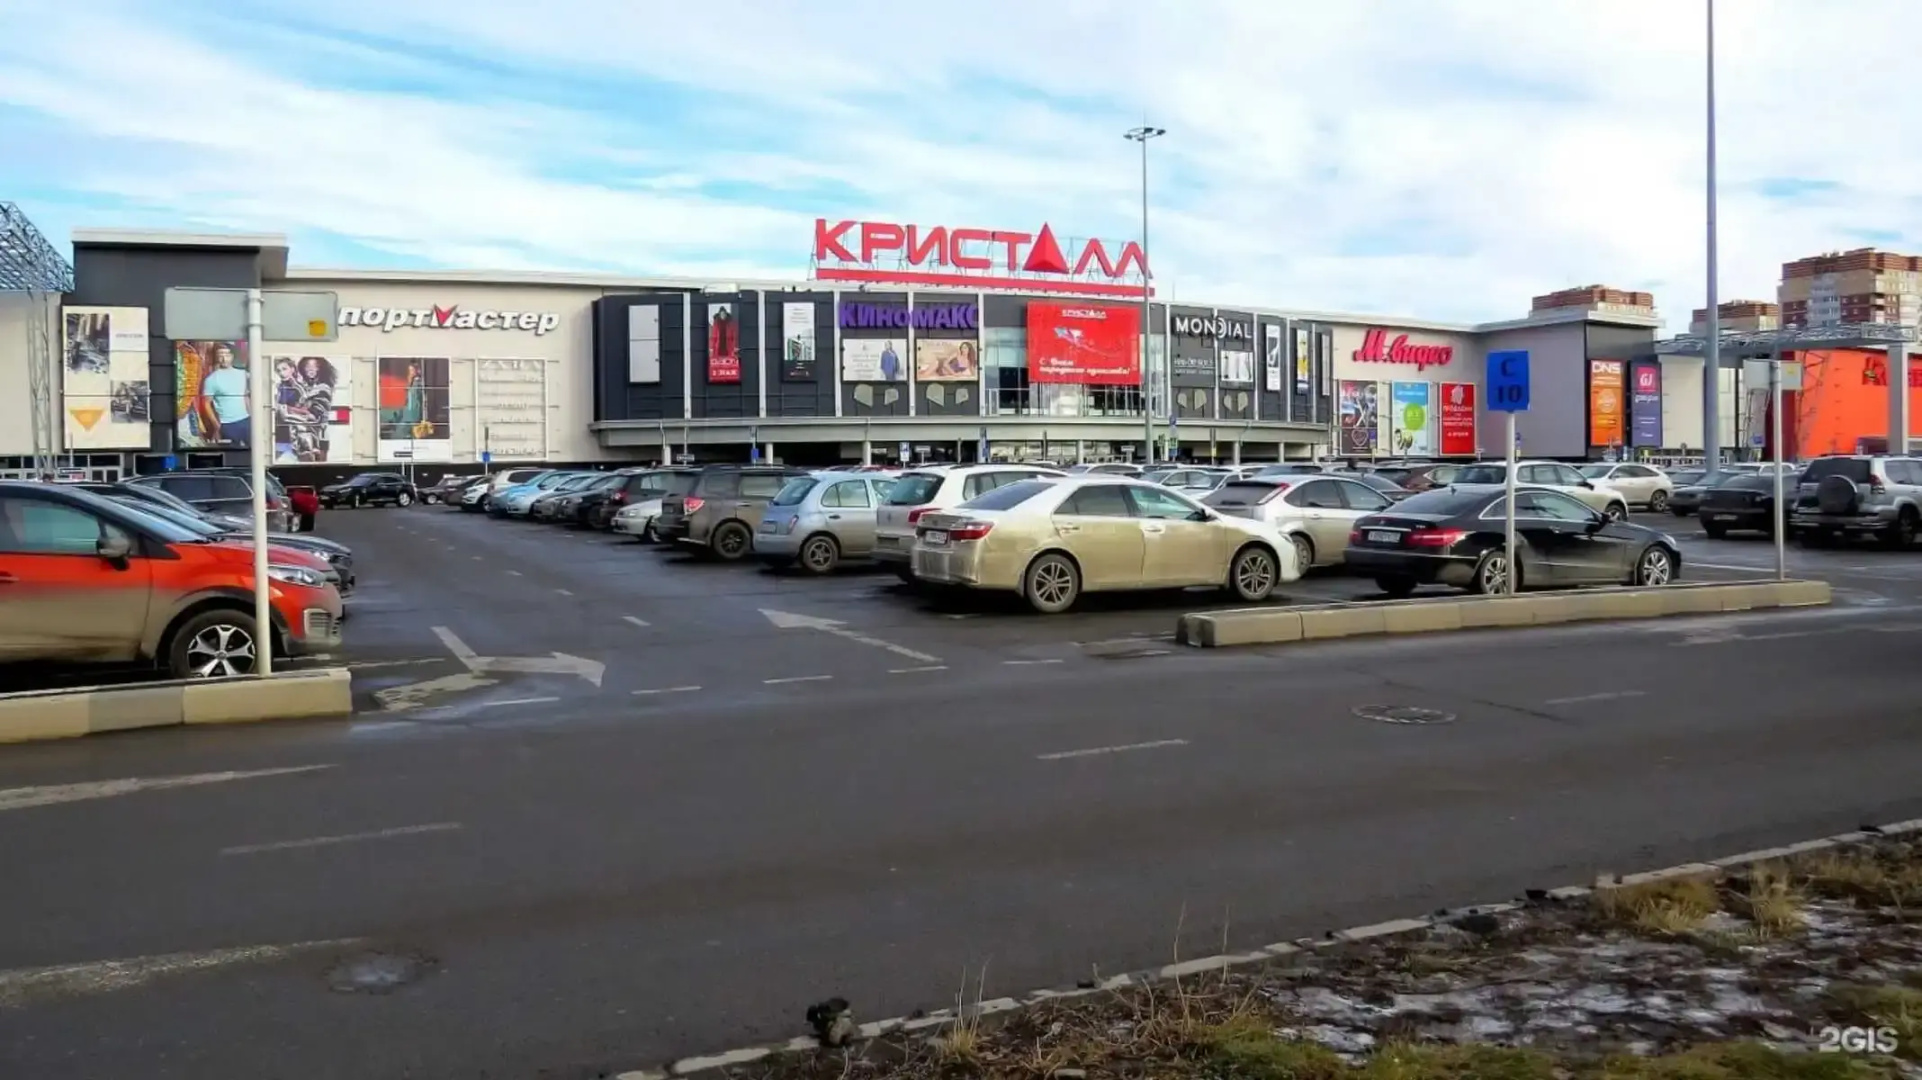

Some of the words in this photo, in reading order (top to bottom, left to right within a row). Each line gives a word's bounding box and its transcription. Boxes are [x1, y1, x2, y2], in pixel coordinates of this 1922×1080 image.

[337, 303, 560, 336] портмастер
[1175, 316, 1252, 339] MONDIAL
[1591, 360, 1621, 374] DNS
[1495, 384, 1523, 404] 10
